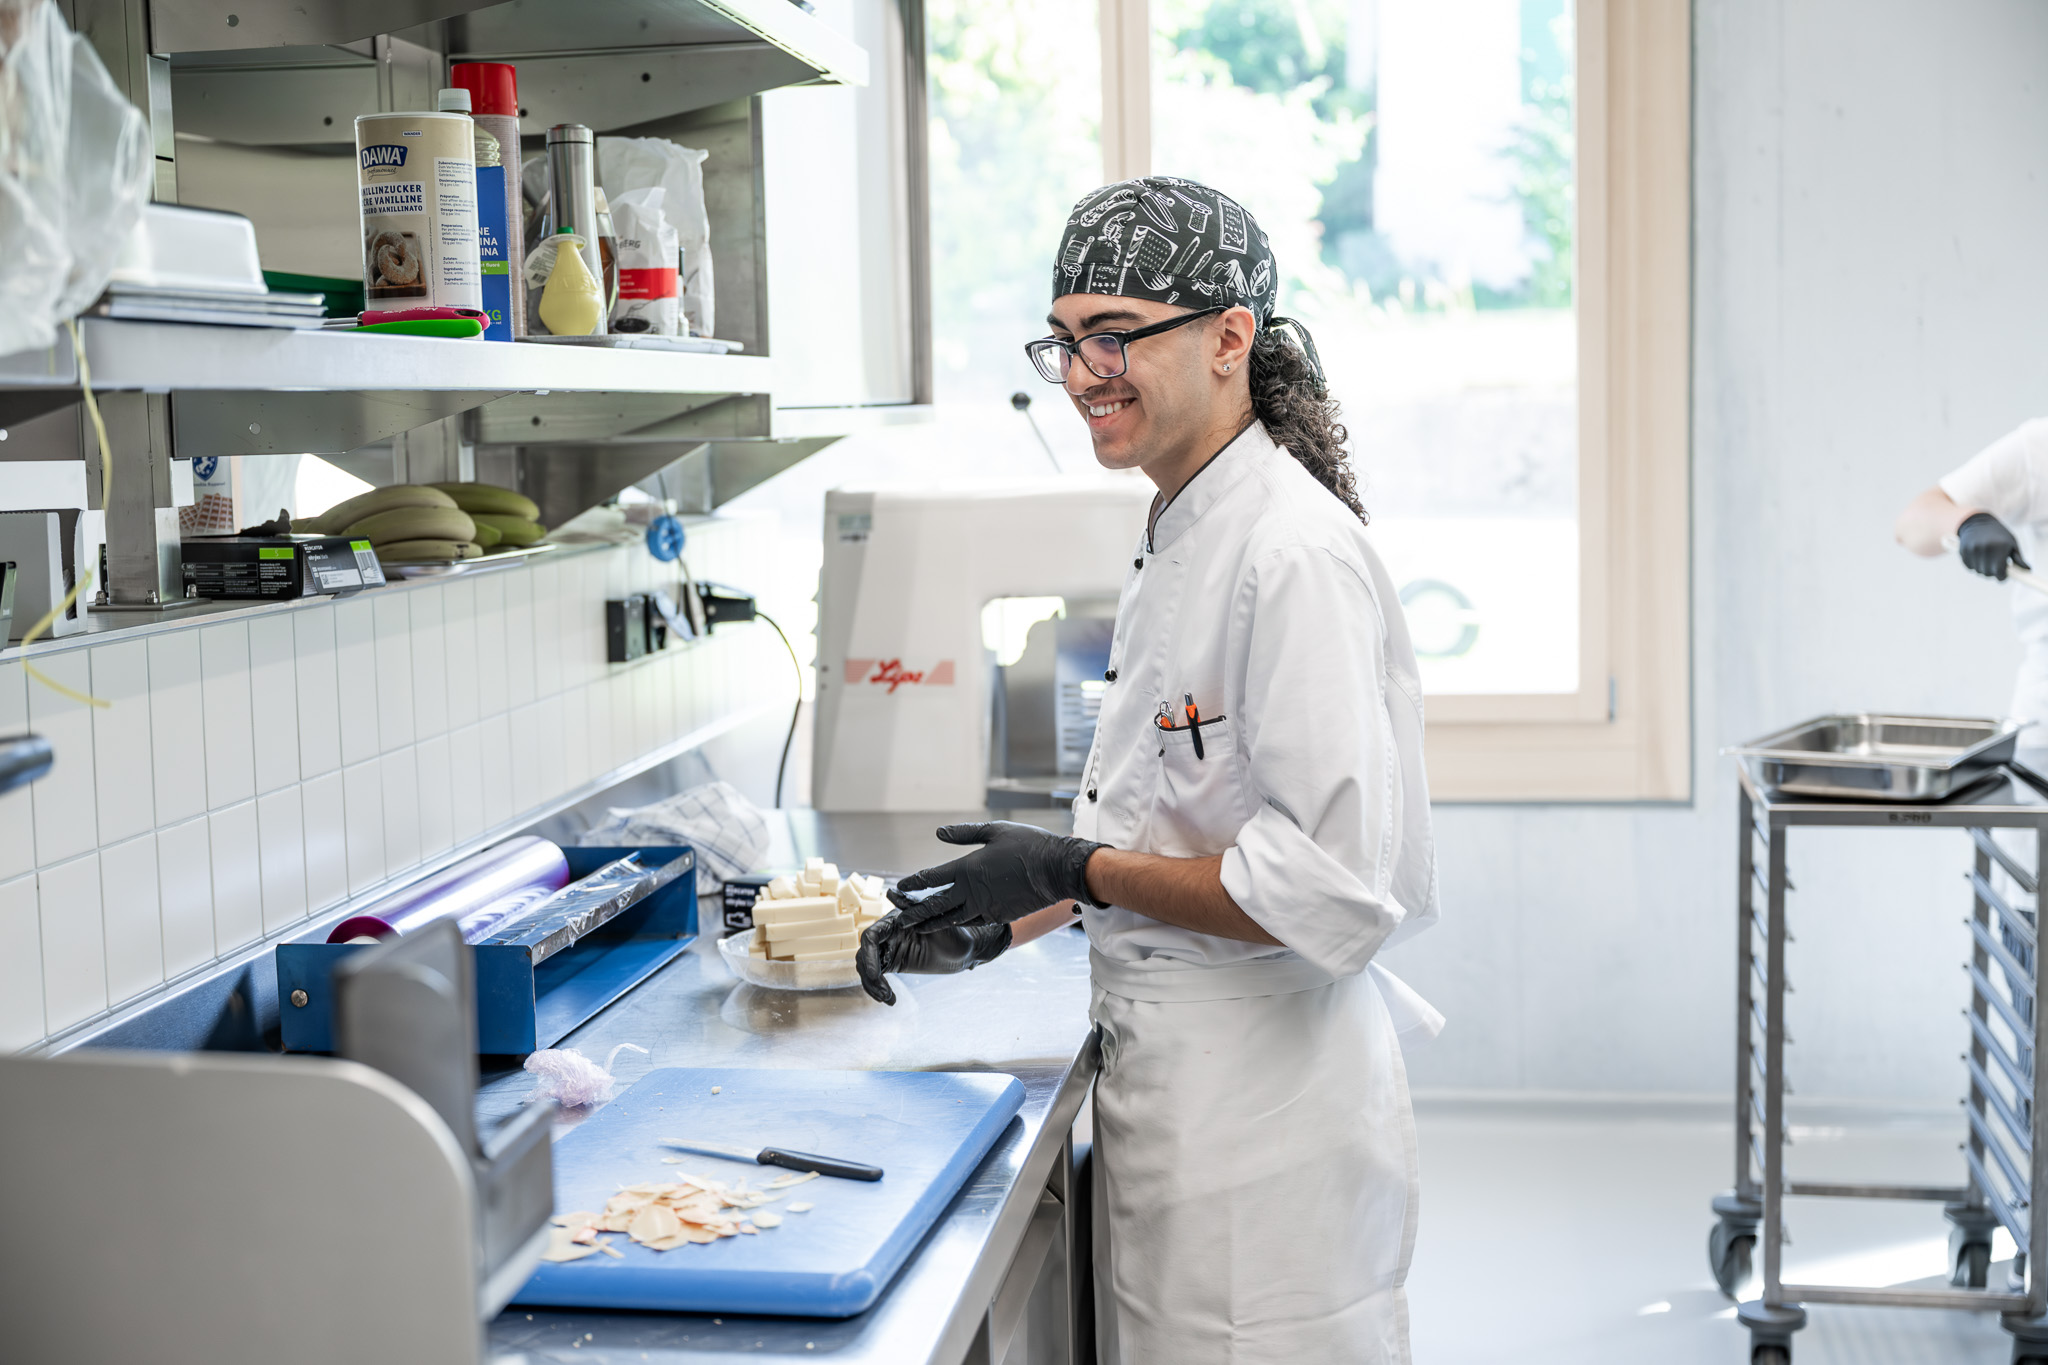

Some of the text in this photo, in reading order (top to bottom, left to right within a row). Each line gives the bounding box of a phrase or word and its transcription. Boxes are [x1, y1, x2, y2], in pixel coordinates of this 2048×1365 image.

[362, 146, 402, 168] DAWA
[361, 184, 422, 196] NILLINZUCKER
[374, 194, 423, 205] VANILLINE
[378, 205, 423, 214] VANILLINATO
[479, 227, 490, 236] NE
[480, 237, 498, 246] INA
[480, 247, 499, 256] INA
